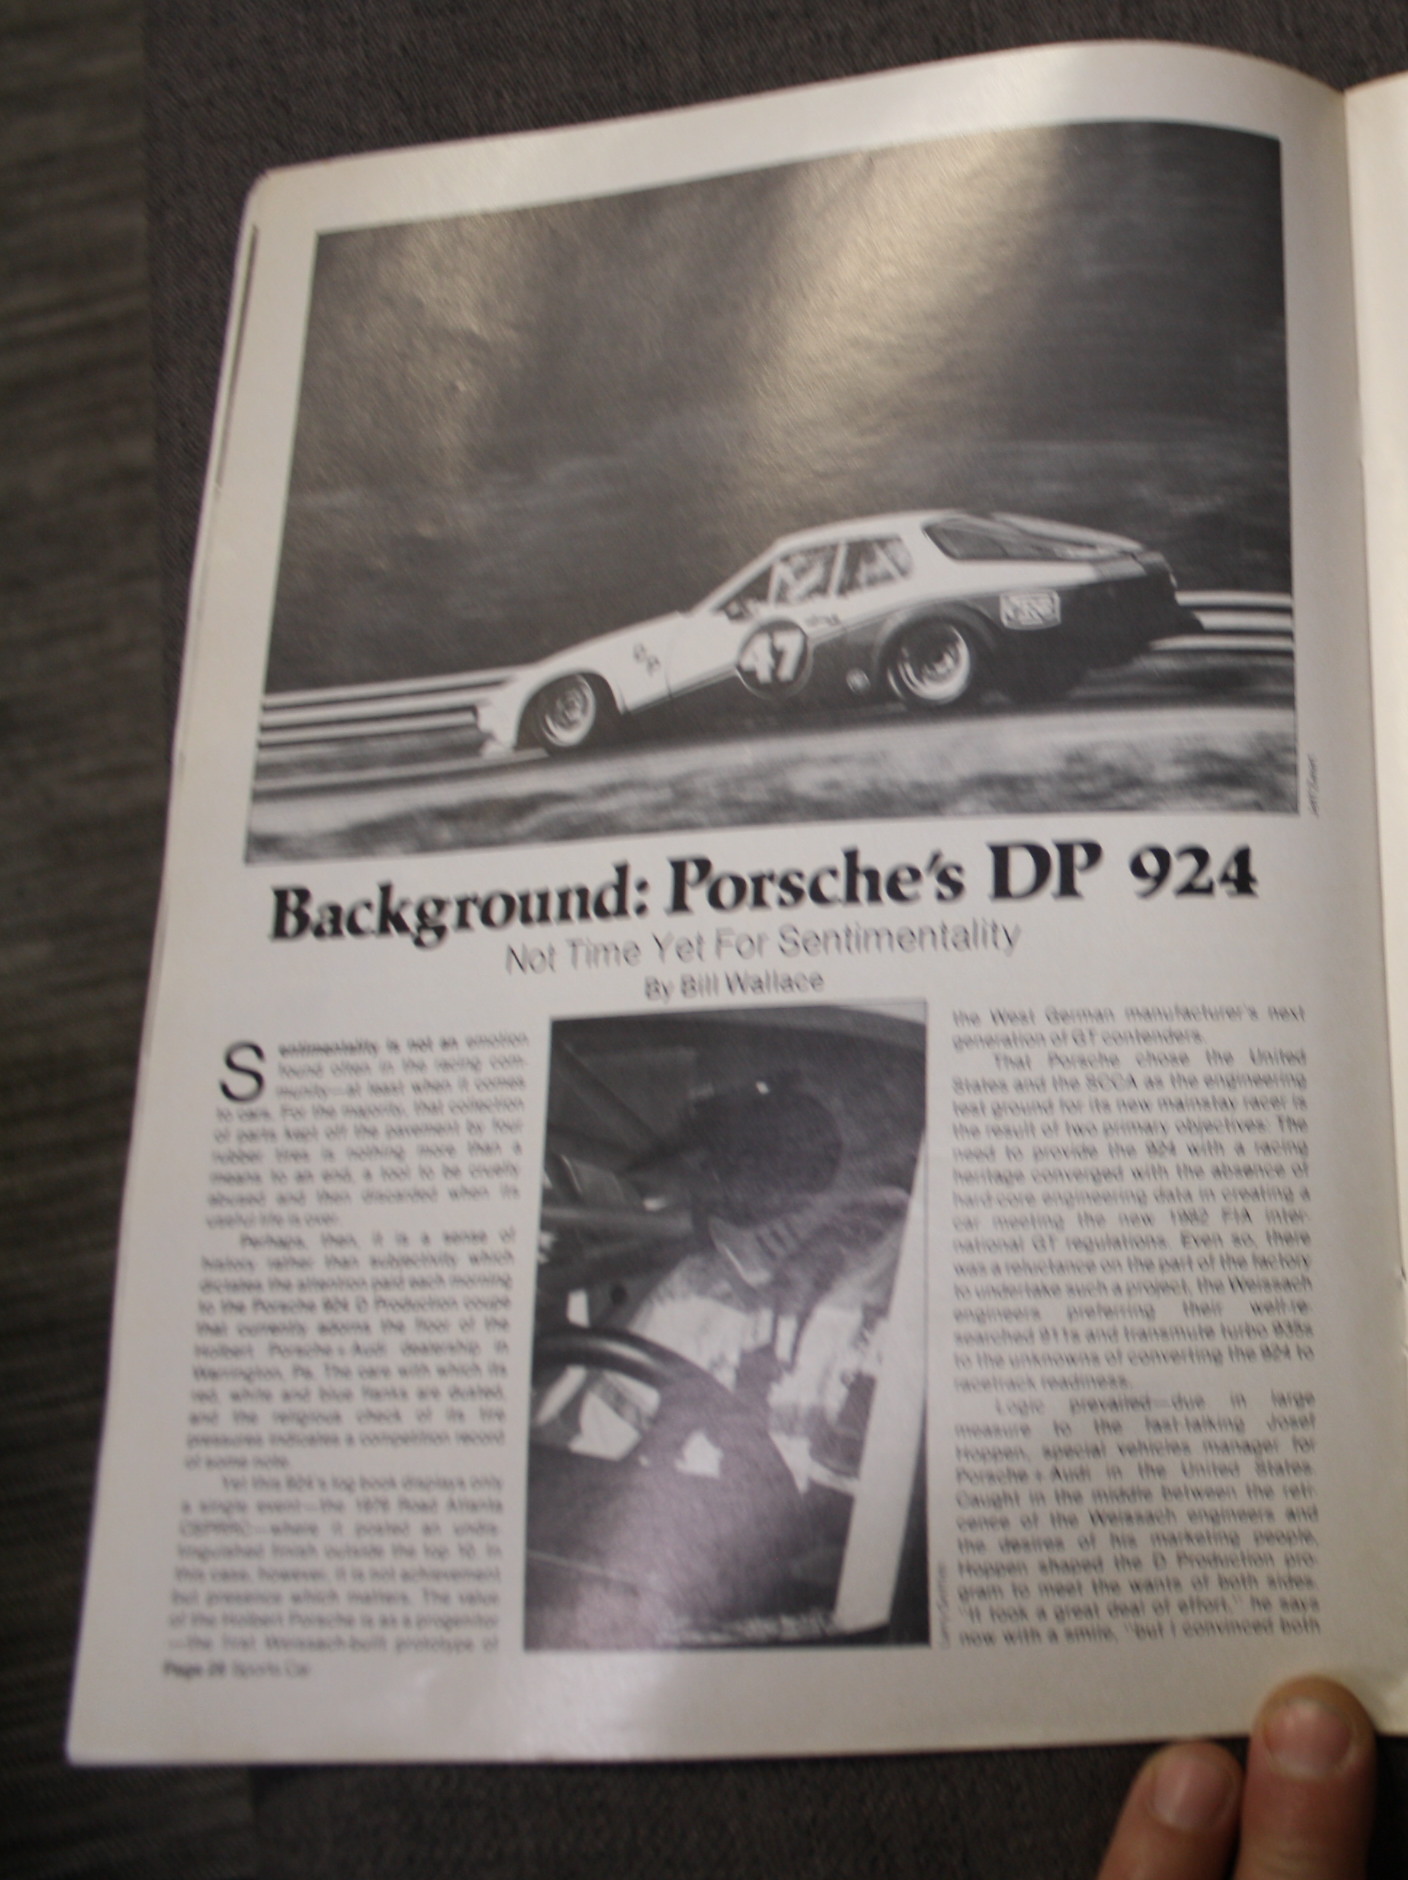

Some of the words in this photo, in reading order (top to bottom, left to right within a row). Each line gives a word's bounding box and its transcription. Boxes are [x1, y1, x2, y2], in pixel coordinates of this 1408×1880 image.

[270, 860, 650, 951] Background:
[666, 846, 965, 917] Porsche's
[985, 839, 1104, 902] DP
[1128, 843, 1259, 899] 924
[505, 942, 557, 975] Not
[565, 936, 641, 969] Time
[651, 931, 704, 963] Yet
[714, 929, 768, 959] For
[777, 917, 1021, 957] Sentimentality
[644, 976, 674, 1002] By
[680, 972, 719, 998] Bill
[725, 967, 825, 995] Wallace
